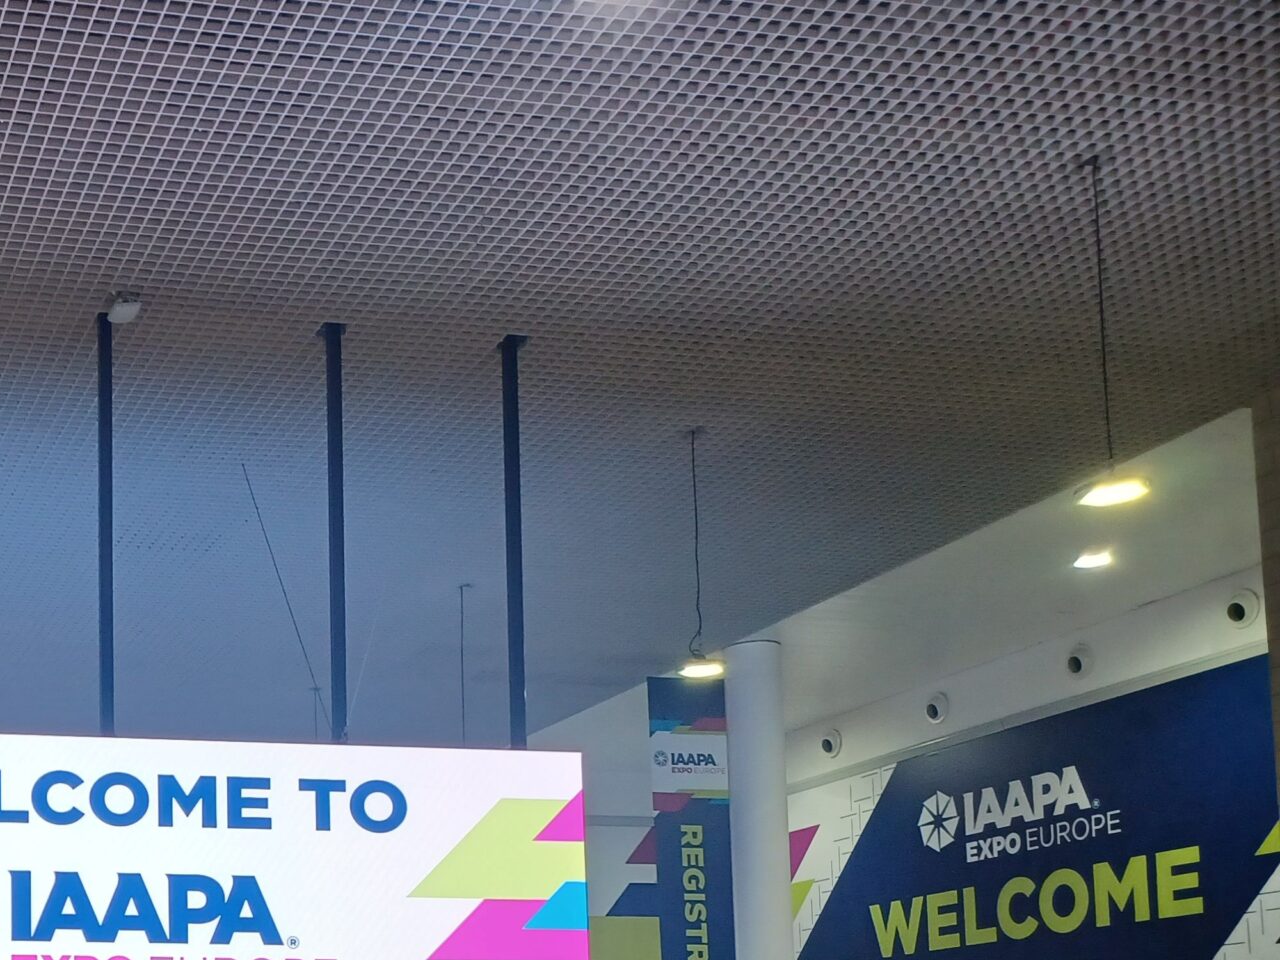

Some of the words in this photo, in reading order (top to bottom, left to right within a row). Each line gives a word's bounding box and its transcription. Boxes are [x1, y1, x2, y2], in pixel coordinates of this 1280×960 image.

[671, 753, 717, 766] IAAPA
[298, 777, 408, 834] TO
[963, 766, 1091, 836] IAAPA
[966, 832, 1020, 863] EXPO
[1025, 809, 1122, 851] EUROPE
[8, 870, 285, 946] IAAPA
[869, 845, 1204, 958] WELCOME
